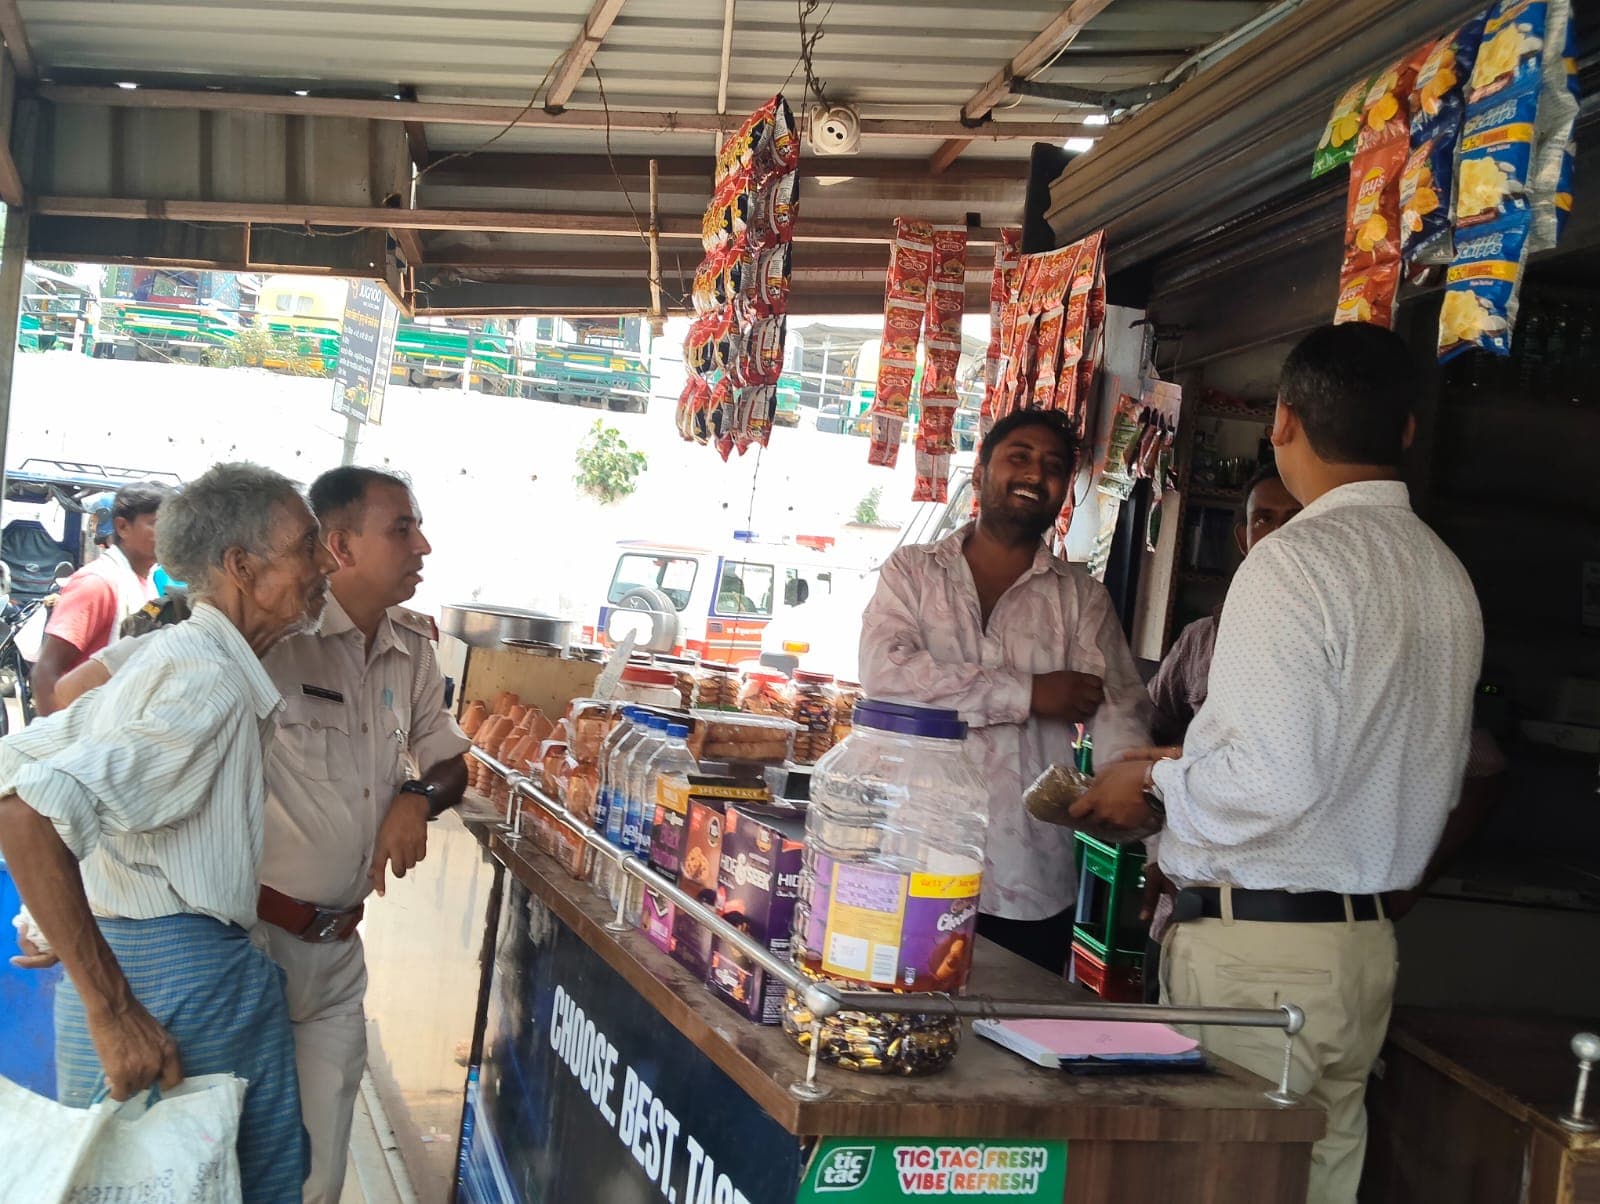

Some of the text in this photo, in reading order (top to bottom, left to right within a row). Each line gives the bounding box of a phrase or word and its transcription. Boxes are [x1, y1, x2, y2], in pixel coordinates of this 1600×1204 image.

[834, 1151, 865, 1168] tic
[897, 1150, 1044, 1168] TIC TAC FRESH
[824, 1167, 862, 1184] tac
[902, 1173, 1035, 1190] VIBE REFRESH
